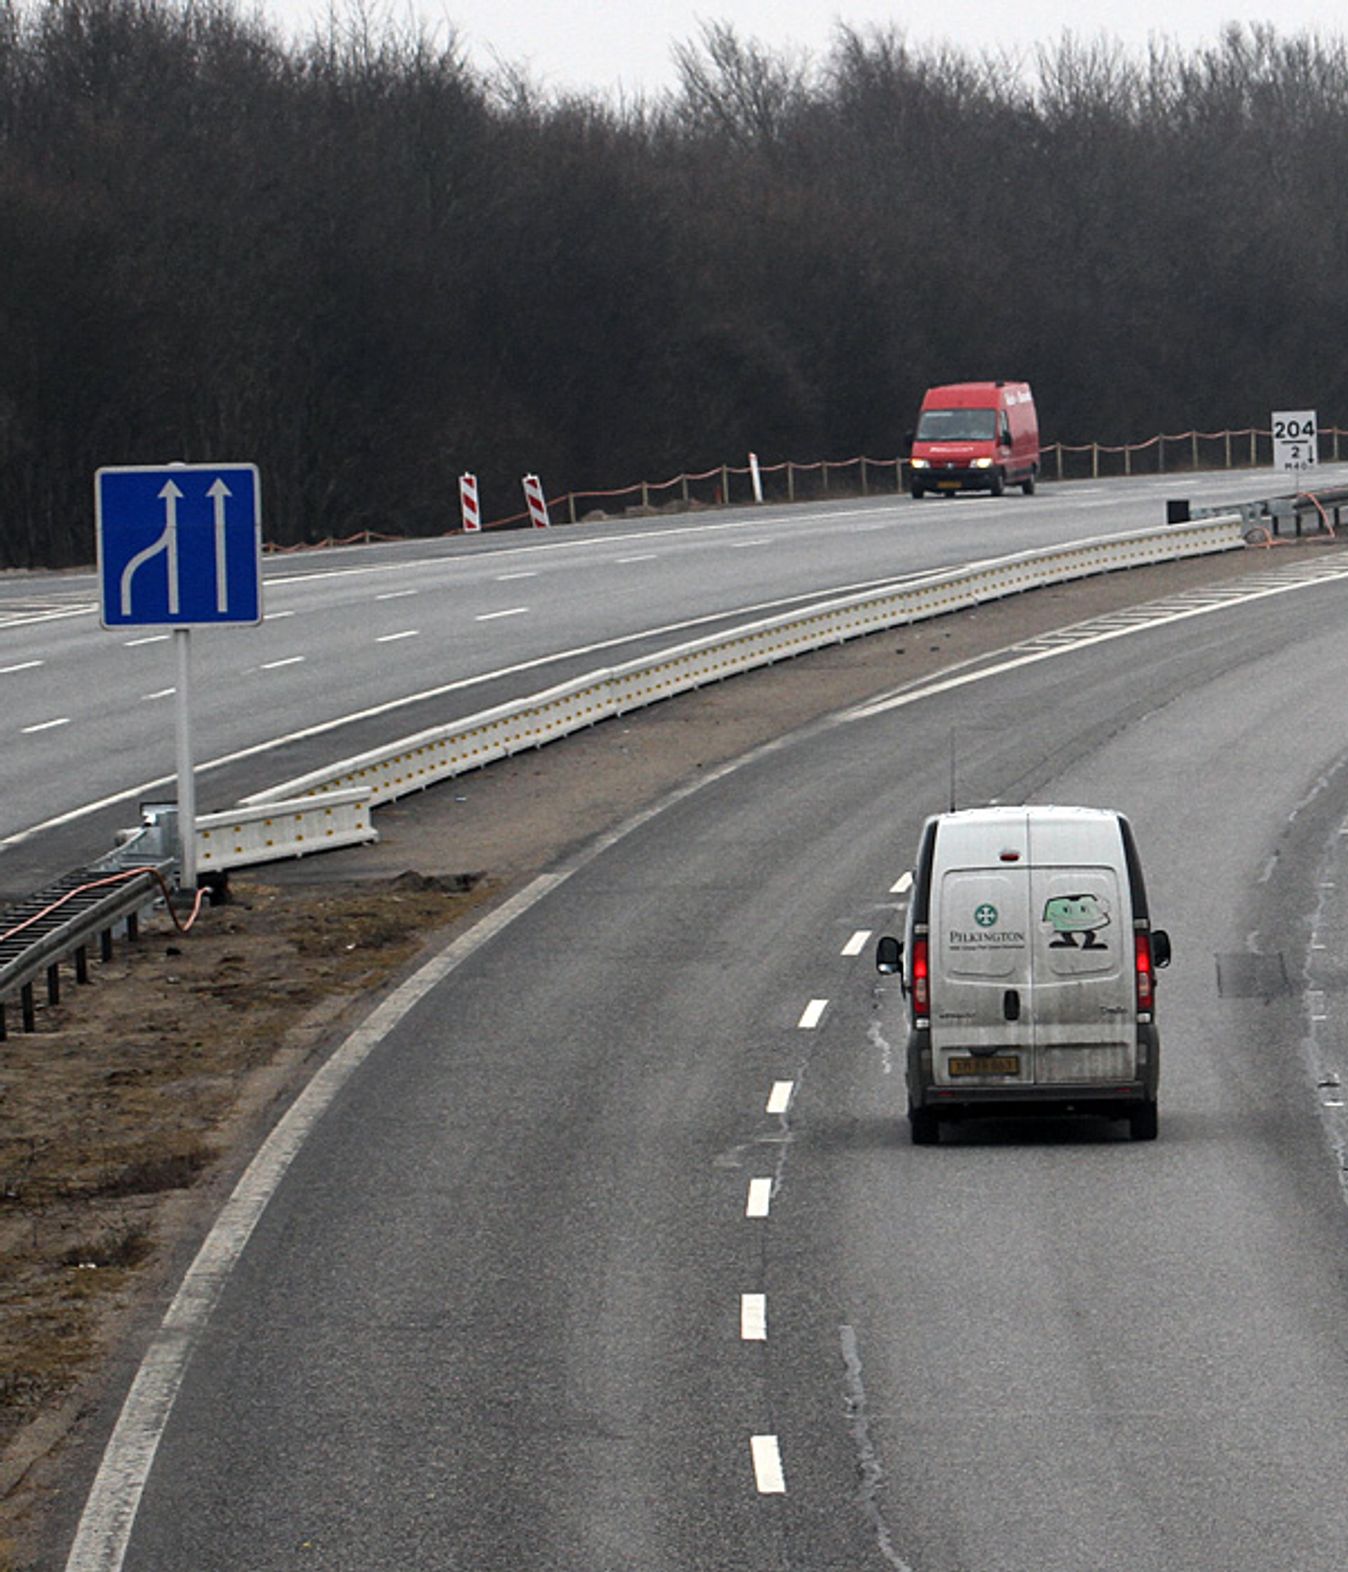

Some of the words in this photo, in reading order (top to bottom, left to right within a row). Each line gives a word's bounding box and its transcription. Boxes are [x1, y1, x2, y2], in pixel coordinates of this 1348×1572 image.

[1274, 420, 1315, 438] 204
[1291, 446, 1300, 458] 2
[950, 931, 1025, 943] PILKINGTON
